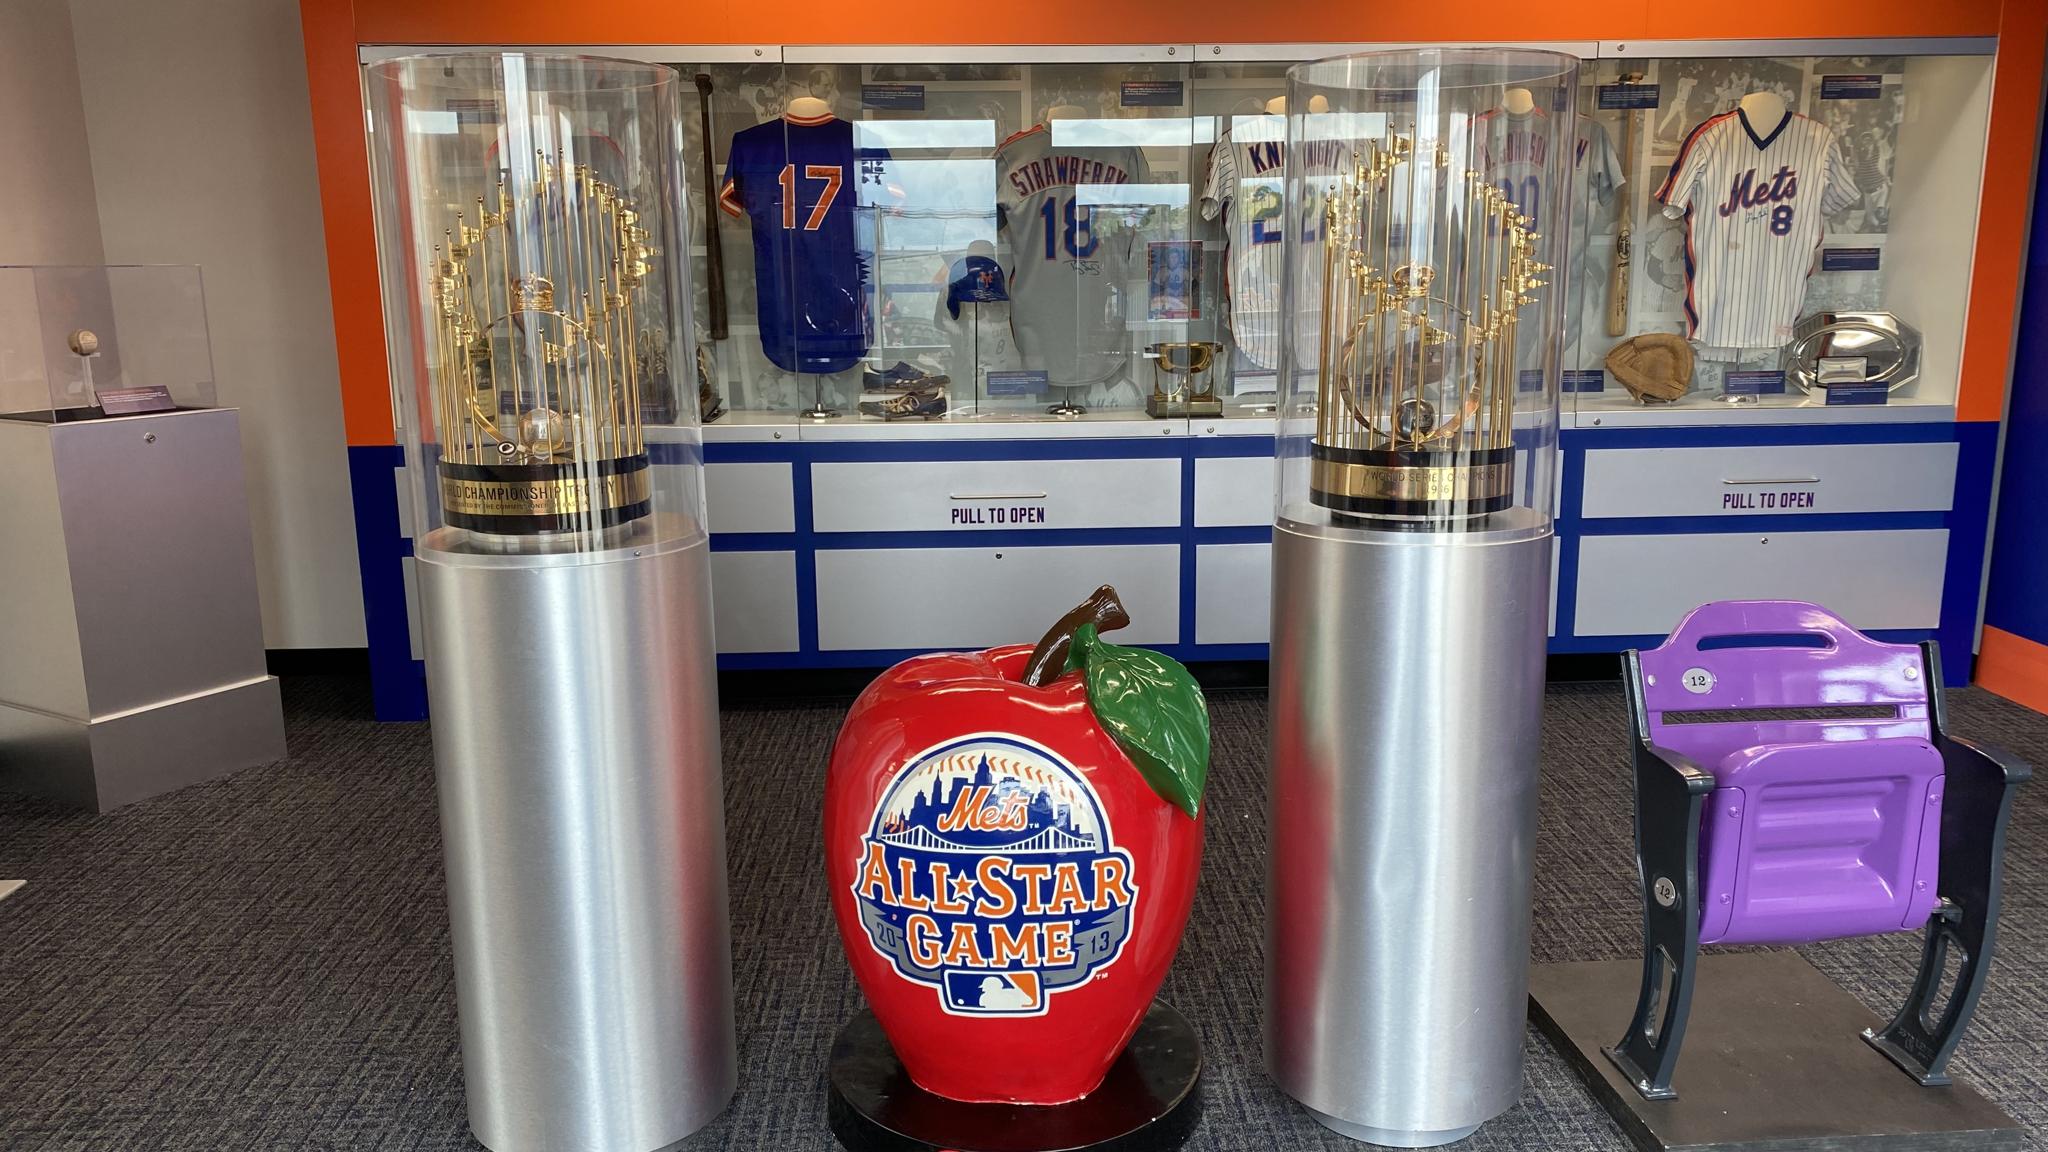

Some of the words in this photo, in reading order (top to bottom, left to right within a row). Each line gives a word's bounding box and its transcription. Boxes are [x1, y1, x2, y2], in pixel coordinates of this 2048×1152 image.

[1009, 156, 1128, 197] STRAWBERRY
[779, 164, 842, 230] 17
[1719, 165, 1797, 217] Mets
[1041, 195, 1098, 260] 18
[1770, 204, 1793, 236] 8
[445, 485, 461, 498] RLD
[465, 485, 561, 500] CHAMPIONSHIP
[567, 480, 615, 498] TROHY
[1409, 472, 1443, 483] SERIE
[1723, 493, 1755, 509] PULL
[1760, 493, 1776, 509] TO
[1780, 492, 1815, 508] OPEN
[952, 508, 985, 524] PULL
[988, 508, 1005, 524] TO
[1010, 507, 1045, 523] OPEN
[1691, 675, 1706, 687] 12
[937, 783, 1030, 832] Mets
[1660, 885, 1671, 900] 12
[876, 922, 896, 948] 20
[906, 914, 1076, 969] GAME
[1090, 931, 1110, 955] 13
